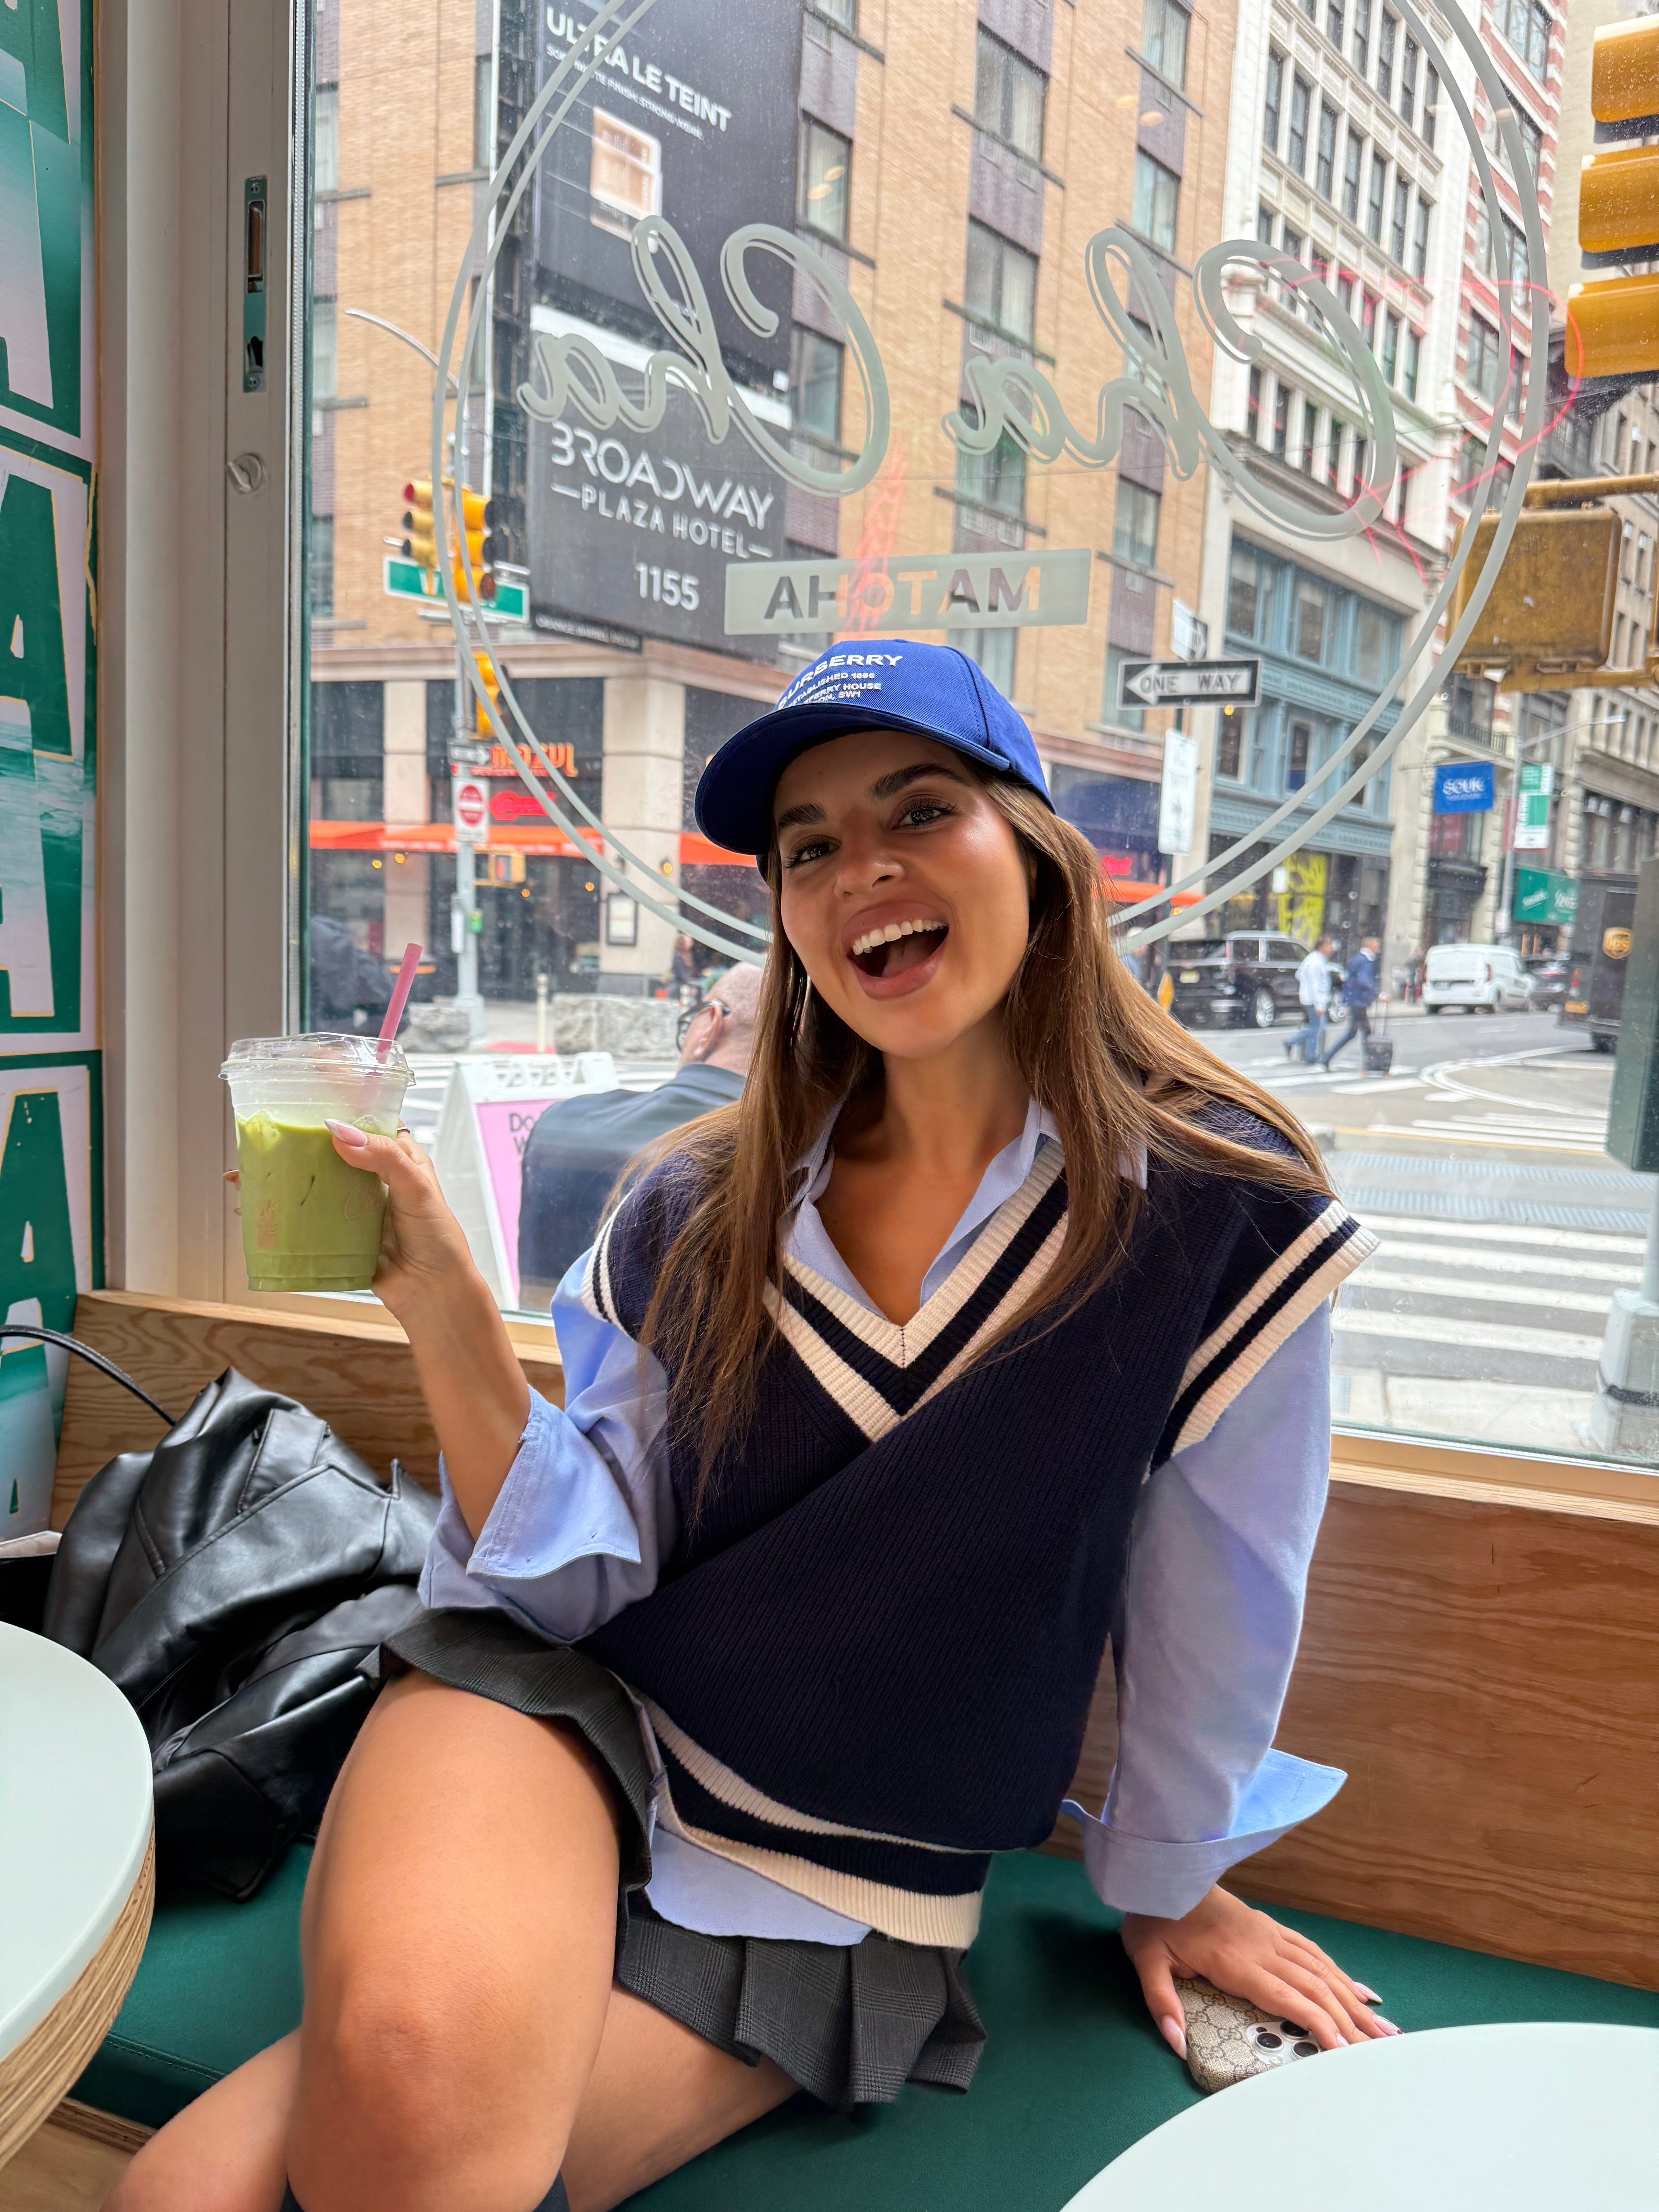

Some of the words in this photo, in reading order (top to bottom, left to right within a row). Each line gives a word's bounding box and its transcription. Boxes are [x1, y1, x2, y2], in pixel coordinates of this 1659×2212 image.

[632, 55, 663, 94] LE
[664, 74, 732, 132] TEINT
[551, 421, 774, 530] BROADWAY
[582, 483, 665, 533] PLAZA
[673, 512, 750, 559] HOTEL
[635, 562, 699, 611] 1155
[1140, 674, 1180, 694] ONE
[1197, 672, 1241, 693] WAY
